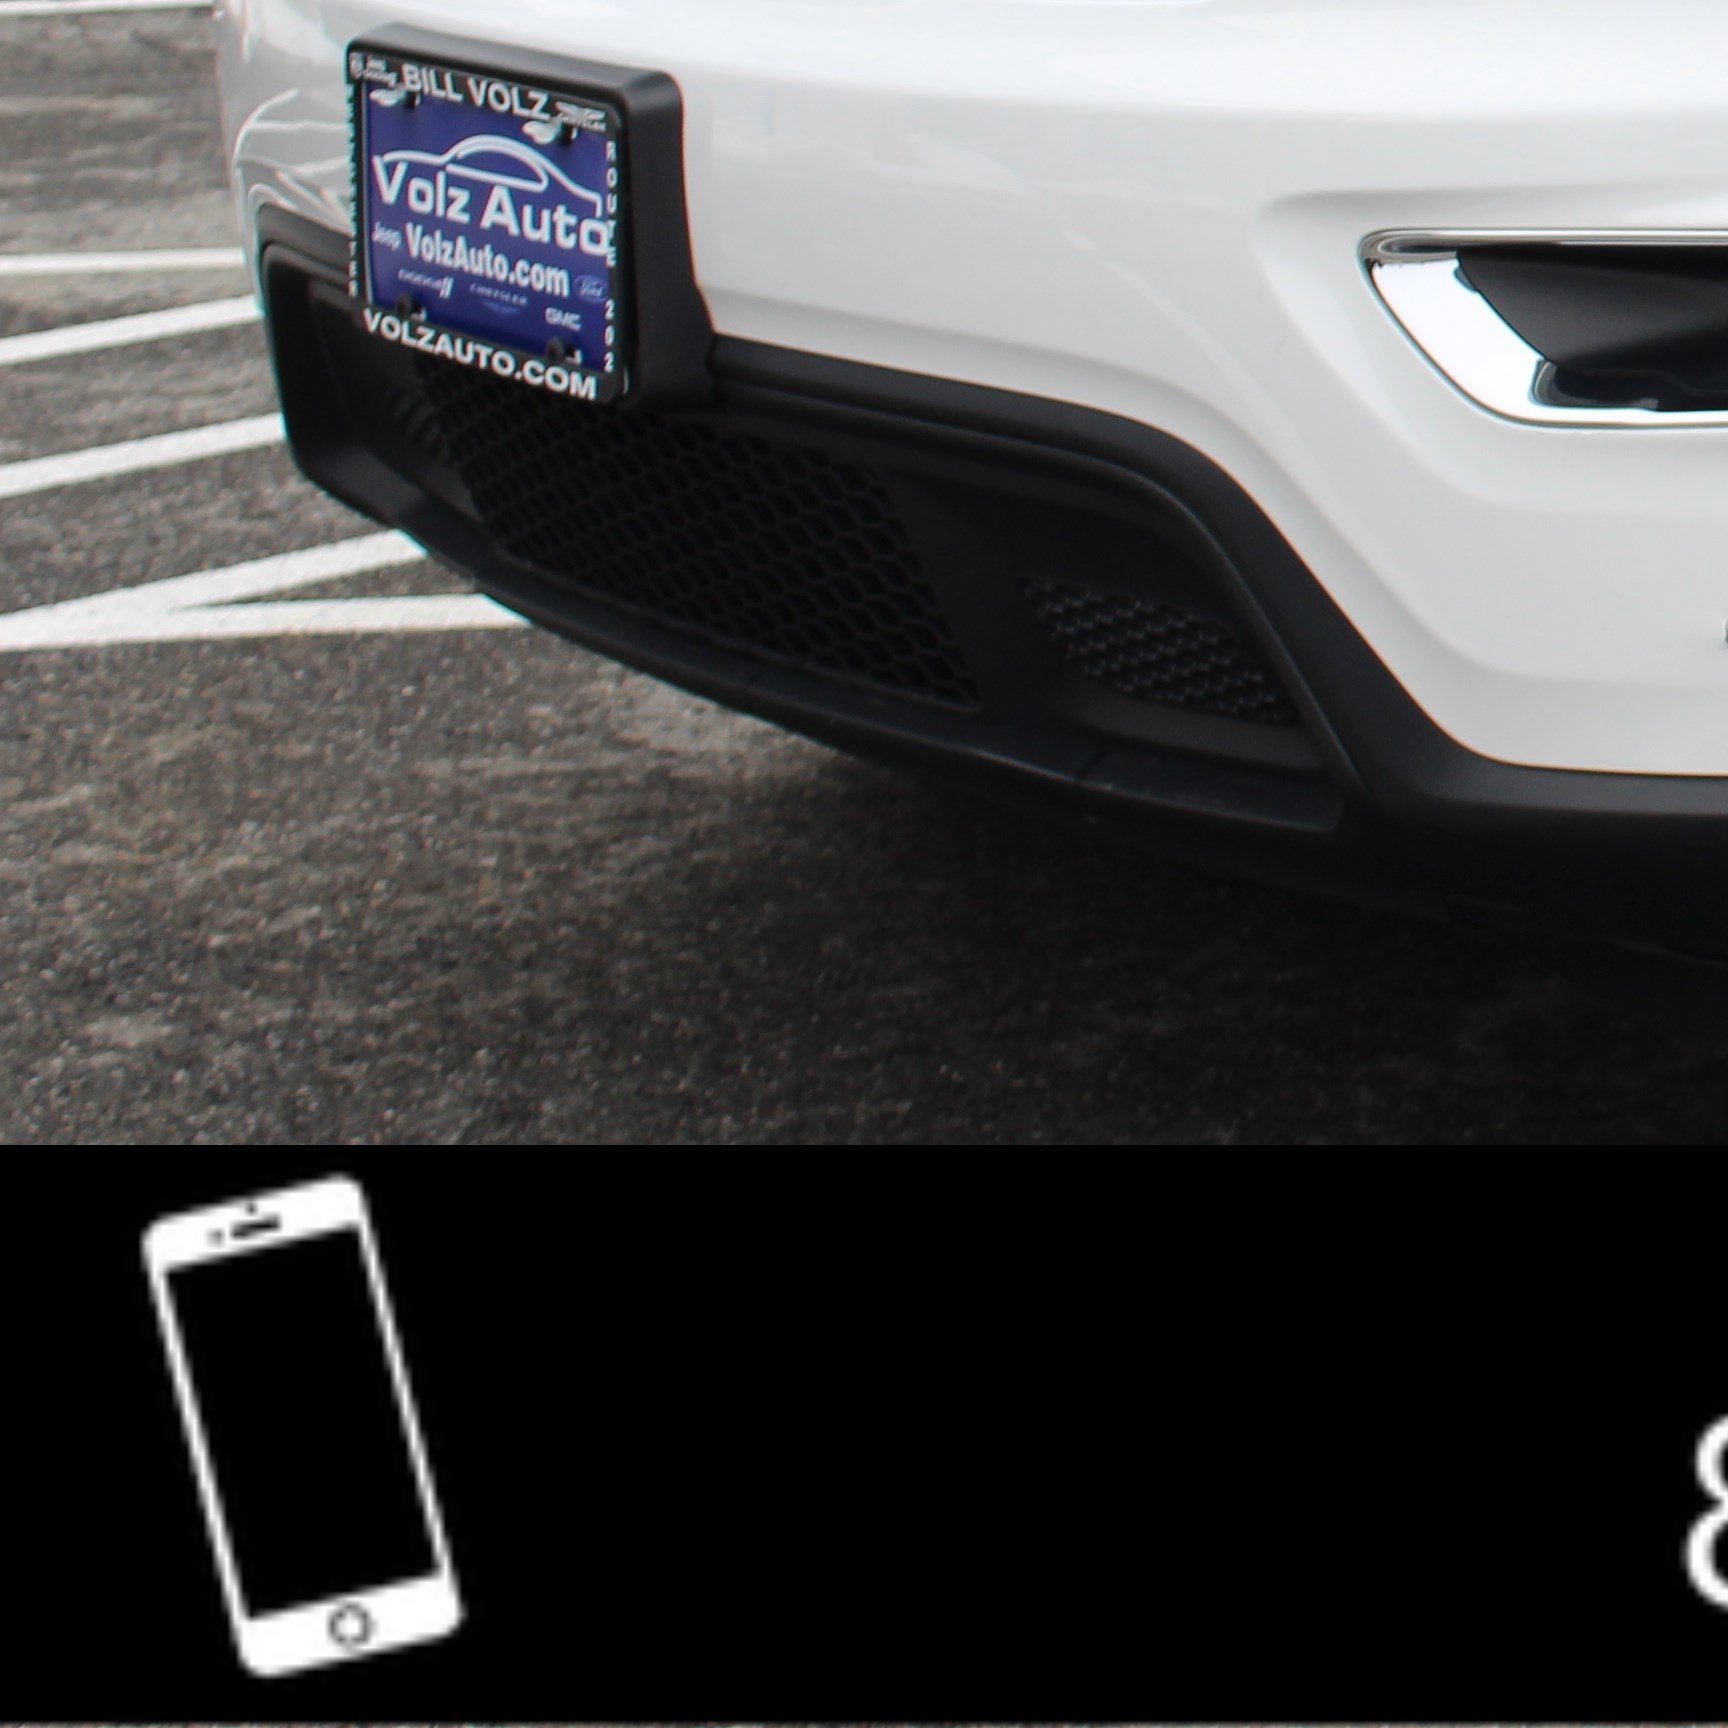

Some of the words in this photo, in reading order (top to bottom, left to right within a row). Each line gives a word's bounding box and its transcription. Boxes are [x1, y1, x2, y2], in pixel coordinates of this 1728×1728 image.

[402, 63, 464, 103] BILL
[467, 77, 551, 122] VOLZ
[373, 154, 470, 223] Volz
[480, 185, 611, 256] Auto
[406, 222, 570, 298] VolzAuto.com
[363, 308, 597, 400] VOLZAUTO.COM
